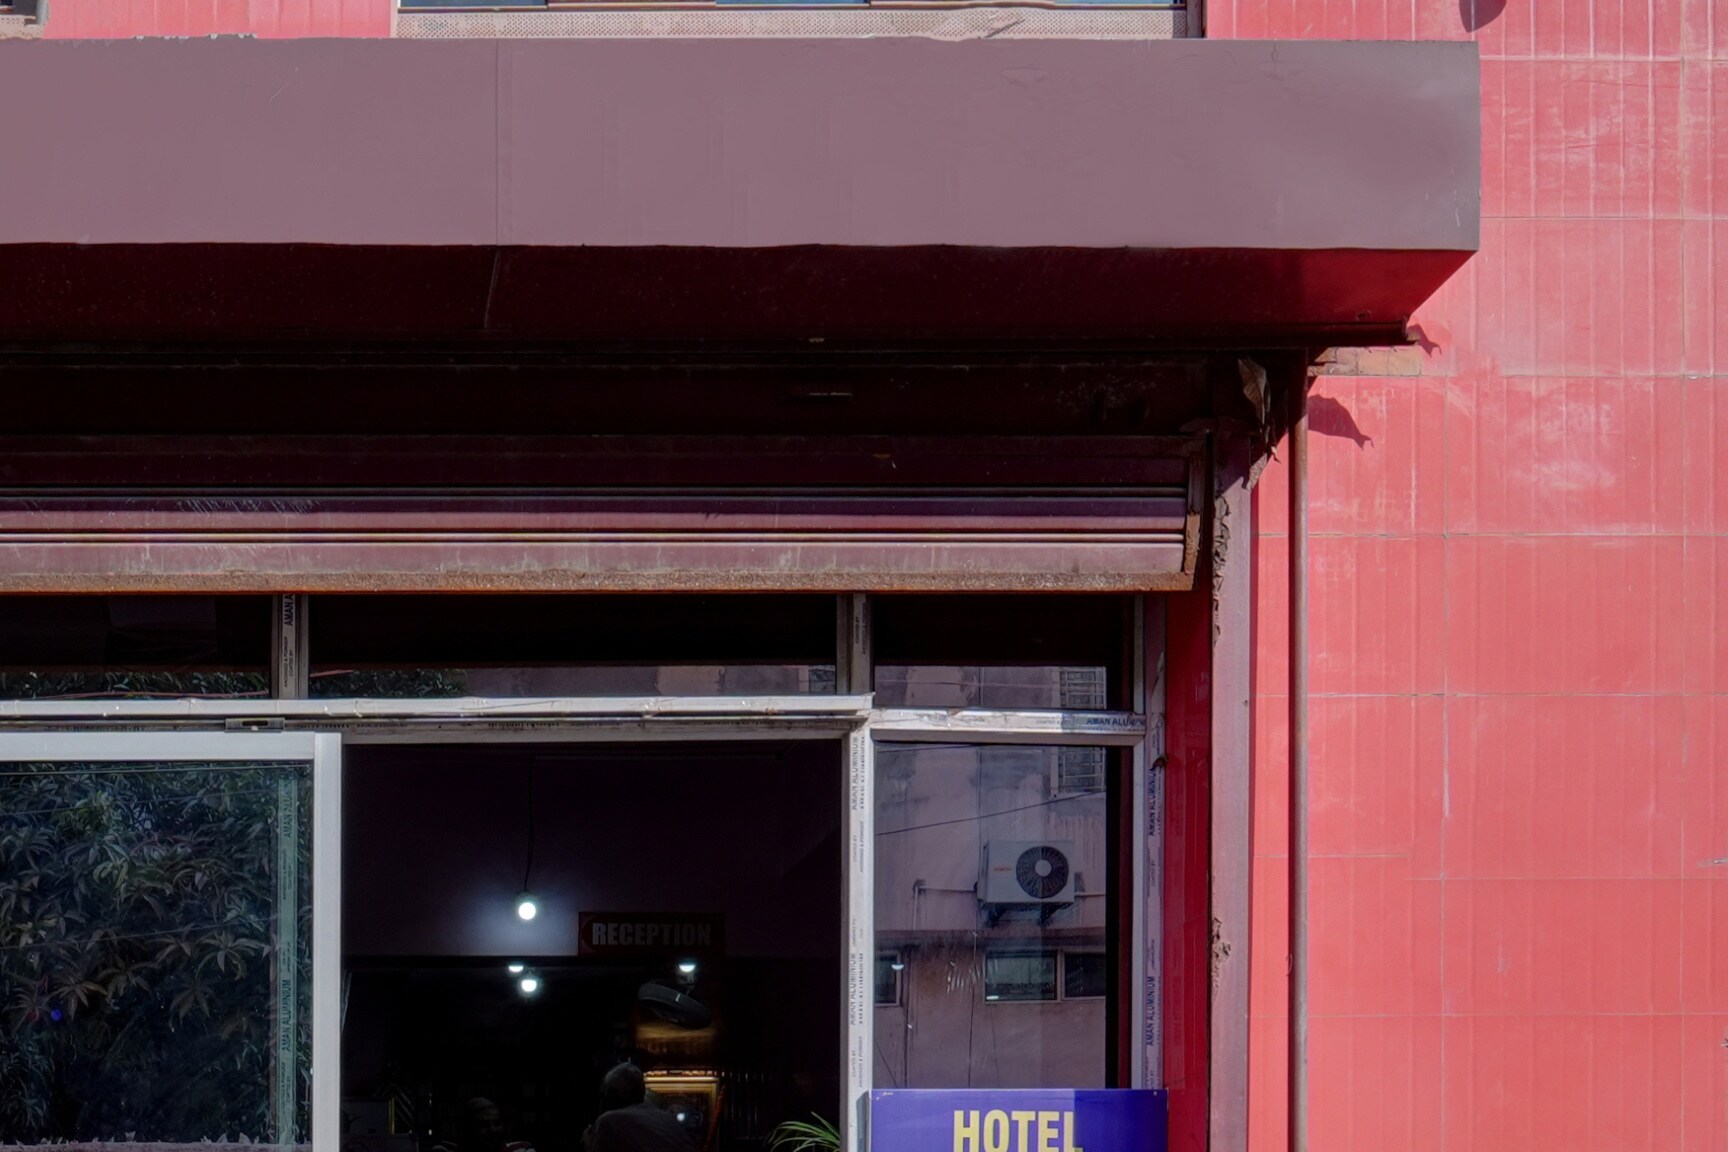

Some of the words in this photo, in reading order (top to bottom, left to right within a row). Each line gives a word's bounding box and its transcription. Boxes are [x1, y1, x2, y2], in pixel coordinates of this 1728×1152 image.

[592, 922, 711, 947] RECEPTION
[1147, 976, 1155, 1021] ALUMINIUM
[1146, 1023, 1154, 1046] AMAN
